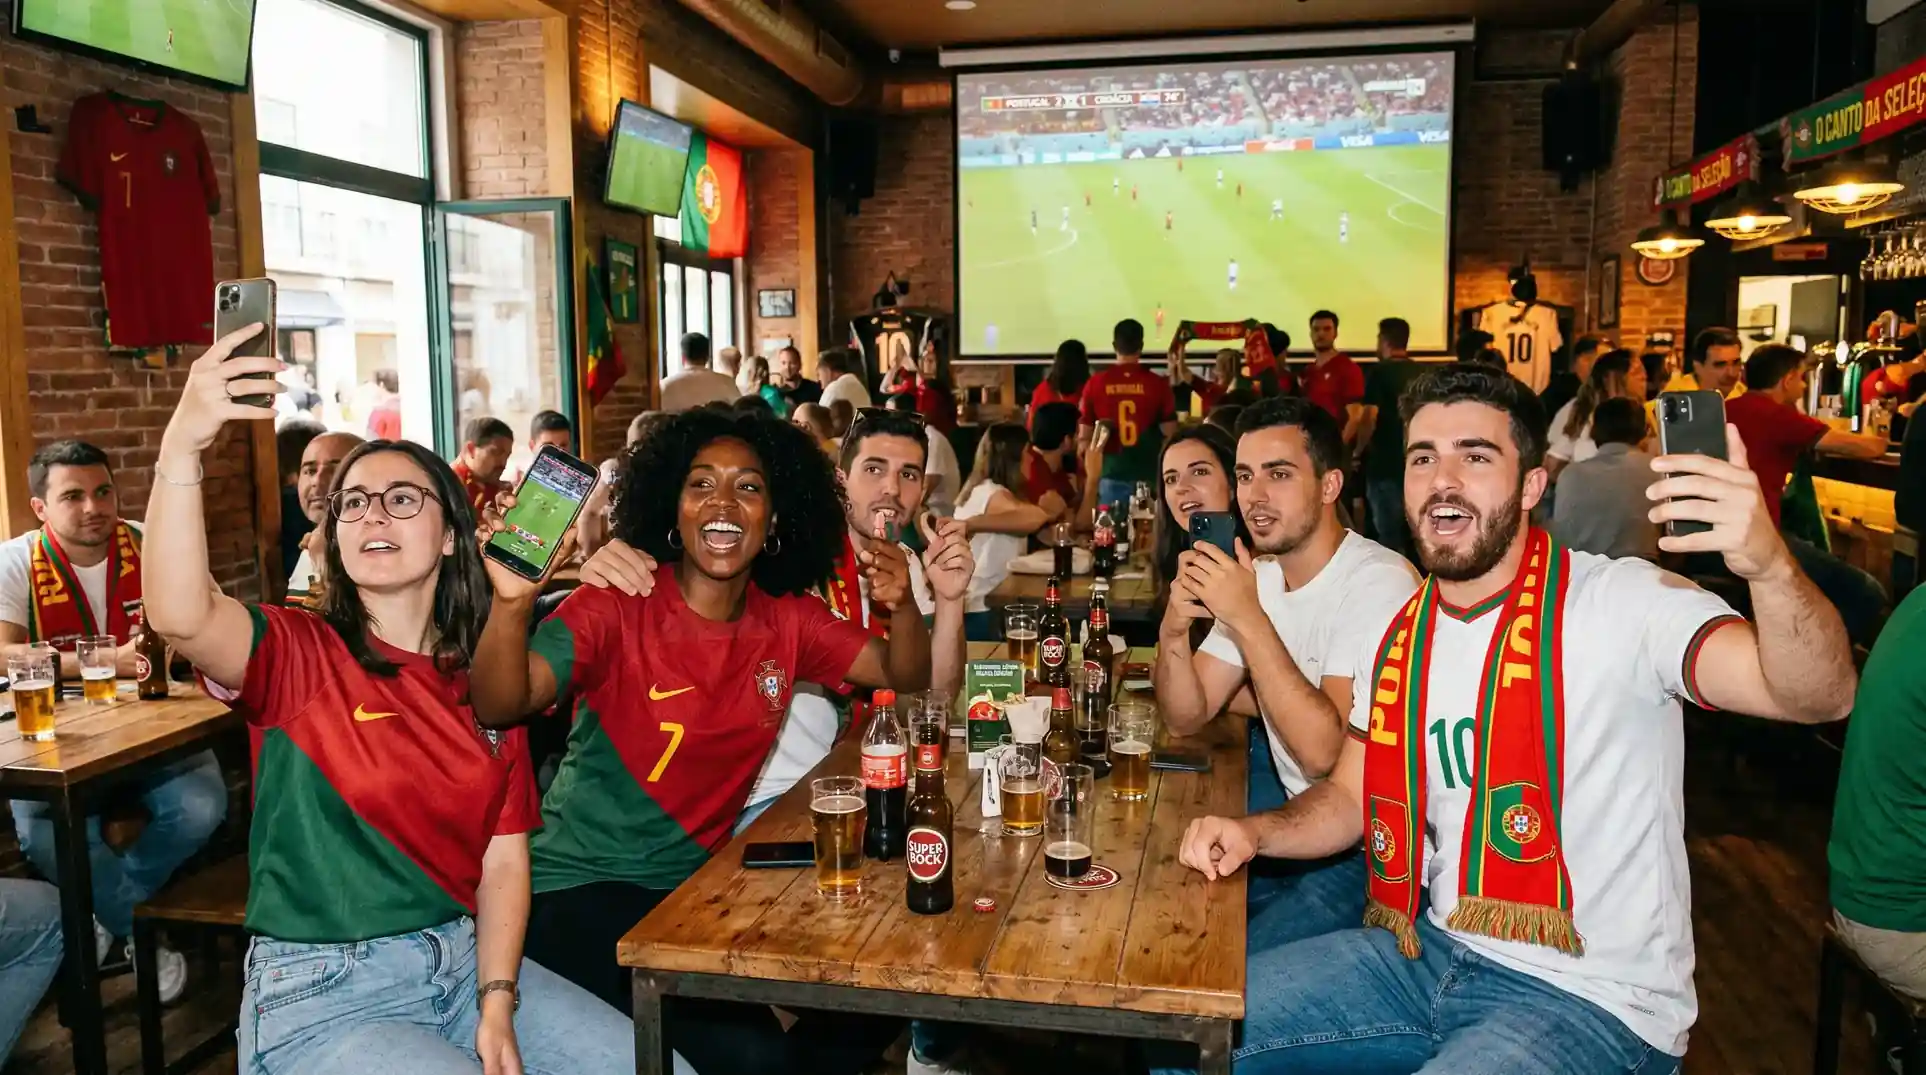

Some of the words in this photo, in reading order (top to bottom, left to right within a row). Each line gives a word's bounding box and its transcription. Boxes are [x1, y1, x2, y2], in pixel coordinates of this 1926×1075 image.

[1417, 130, 1449, 143] VISA
[1815, 116, 1825, 144] O
[1825, 101, 1863, 142] CANTO
[1864, 96, 1881, 128] DA
[1340, 135, 1374, 148] VISA
[875, 331, 911, 374] 10
[1507, 332, 1532, 364] 10
[1118, 400, 1137, 447] 6
[647, 721, 685, 783] 7
[1429, 716, 1476, 789] 10
[908, 840, 943, 855] SUPER
[910, 852, 942, 865] BOCK
